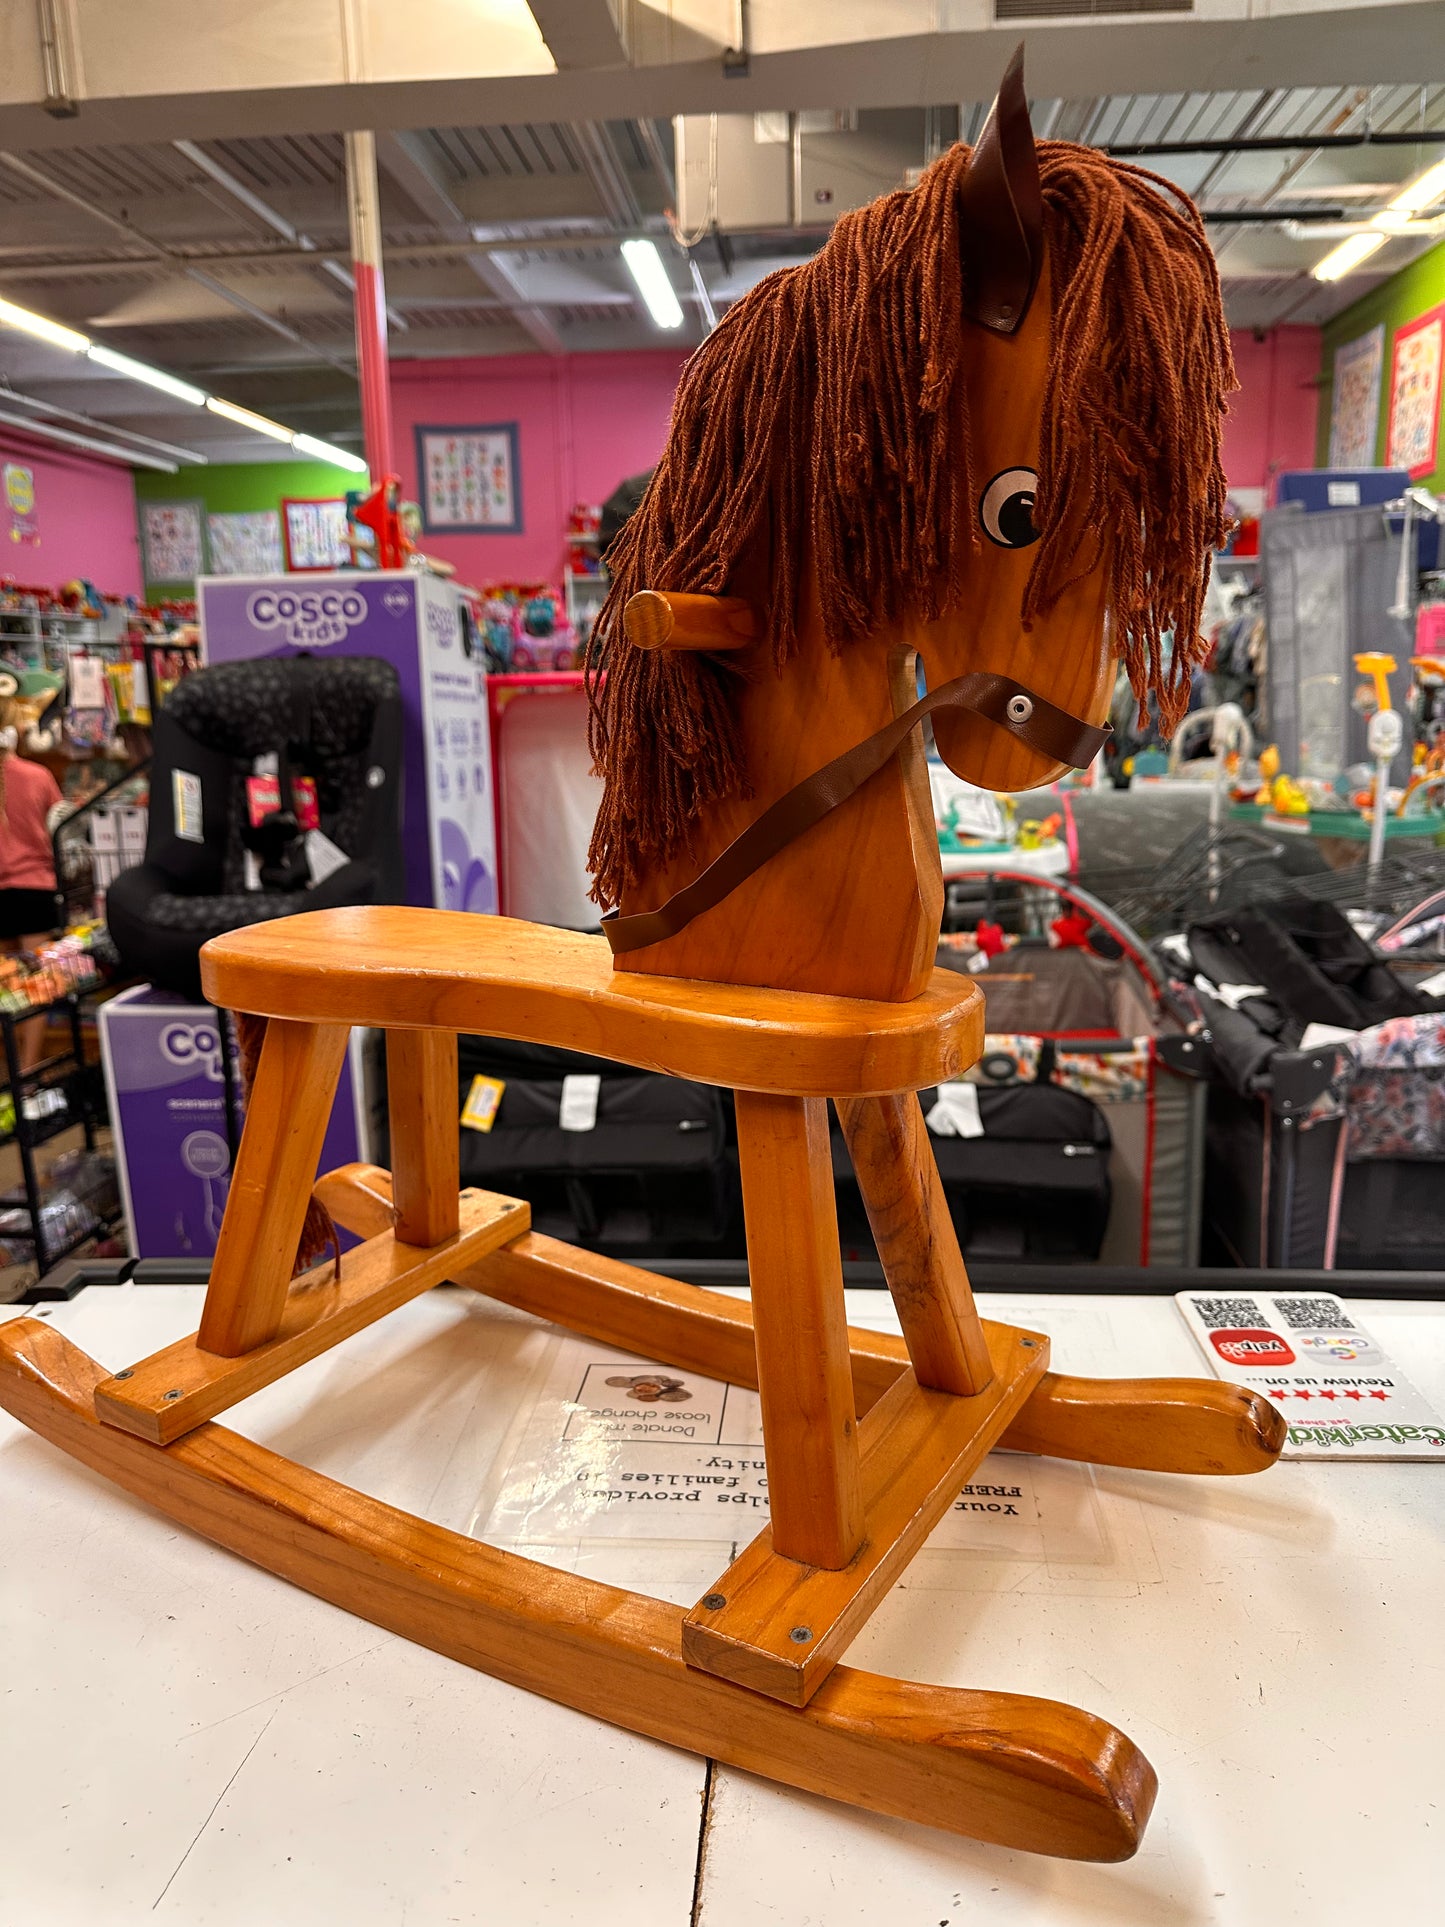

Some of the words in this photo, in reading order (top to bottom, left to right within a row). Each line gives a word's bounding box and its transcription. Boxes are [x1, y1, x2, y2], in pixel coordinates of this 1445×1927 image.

[1242, 1339, 1285, 1353] yelp
[1301, 1336, 1369, 1348] Google
[1296, 1378, 1318, 1386] us
[1324, 1377, 1395, 1388] Review
[590, 1408, 657, 1421] change
[664, 1411, 711, 1424] loose
[632, 1423, 696, 1437] Donate
[621, 1472, 740, 1487] families
[961, 1484, 1022, 1497] FREE
[717, 1493, 770, 1508] elps
[954, 1501, 1019, 1515] Your
